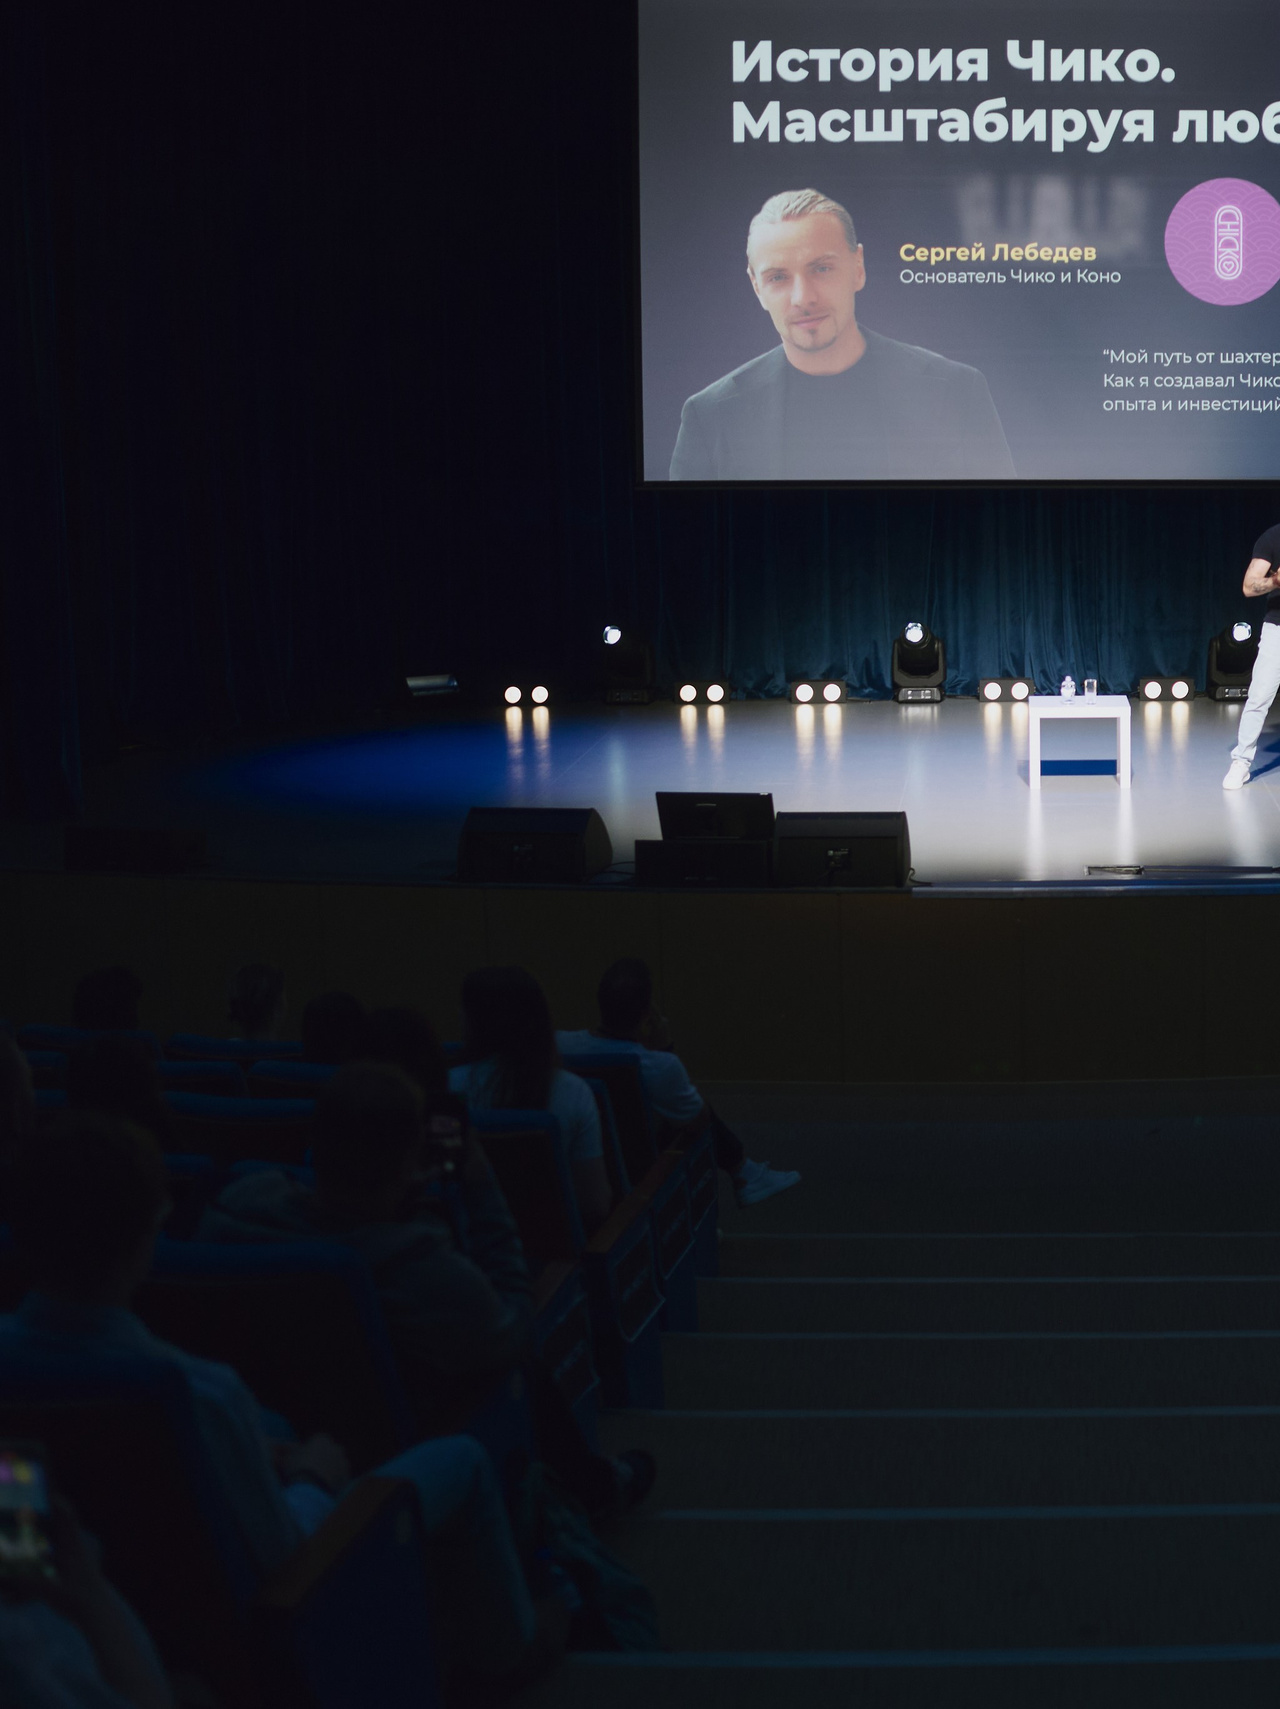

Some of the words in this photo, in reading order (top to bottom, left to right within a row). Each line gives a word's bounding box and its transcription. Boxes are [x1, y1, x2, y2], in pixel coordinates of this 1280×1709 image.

[731, 39, 989, 93] История
[1006, 39, 1176, 84] Чико.
[732, 96, 1155, 154] Масштабируя
[899, 242, 986, 265] Сергей
[991, 242, 1097, 263] Лебедев
[899, 268, 1007, 284] Основатель
[1010, 268, 1056, 284] Чико
[1060, 271, 1072, 284] и
[1076, 268, 1122, 284] Коно
[1153, 352, 1193, 367] путь
[1195, 352, 1216, 364] от
[1103, 373, 1135, 388] Как
[1139, 376, 1149, 388] я
[1153, 376, 1235, 390] создавал
[1102, 399, 1157, 412] опыта
[1161, 399, 1173, 411] и
